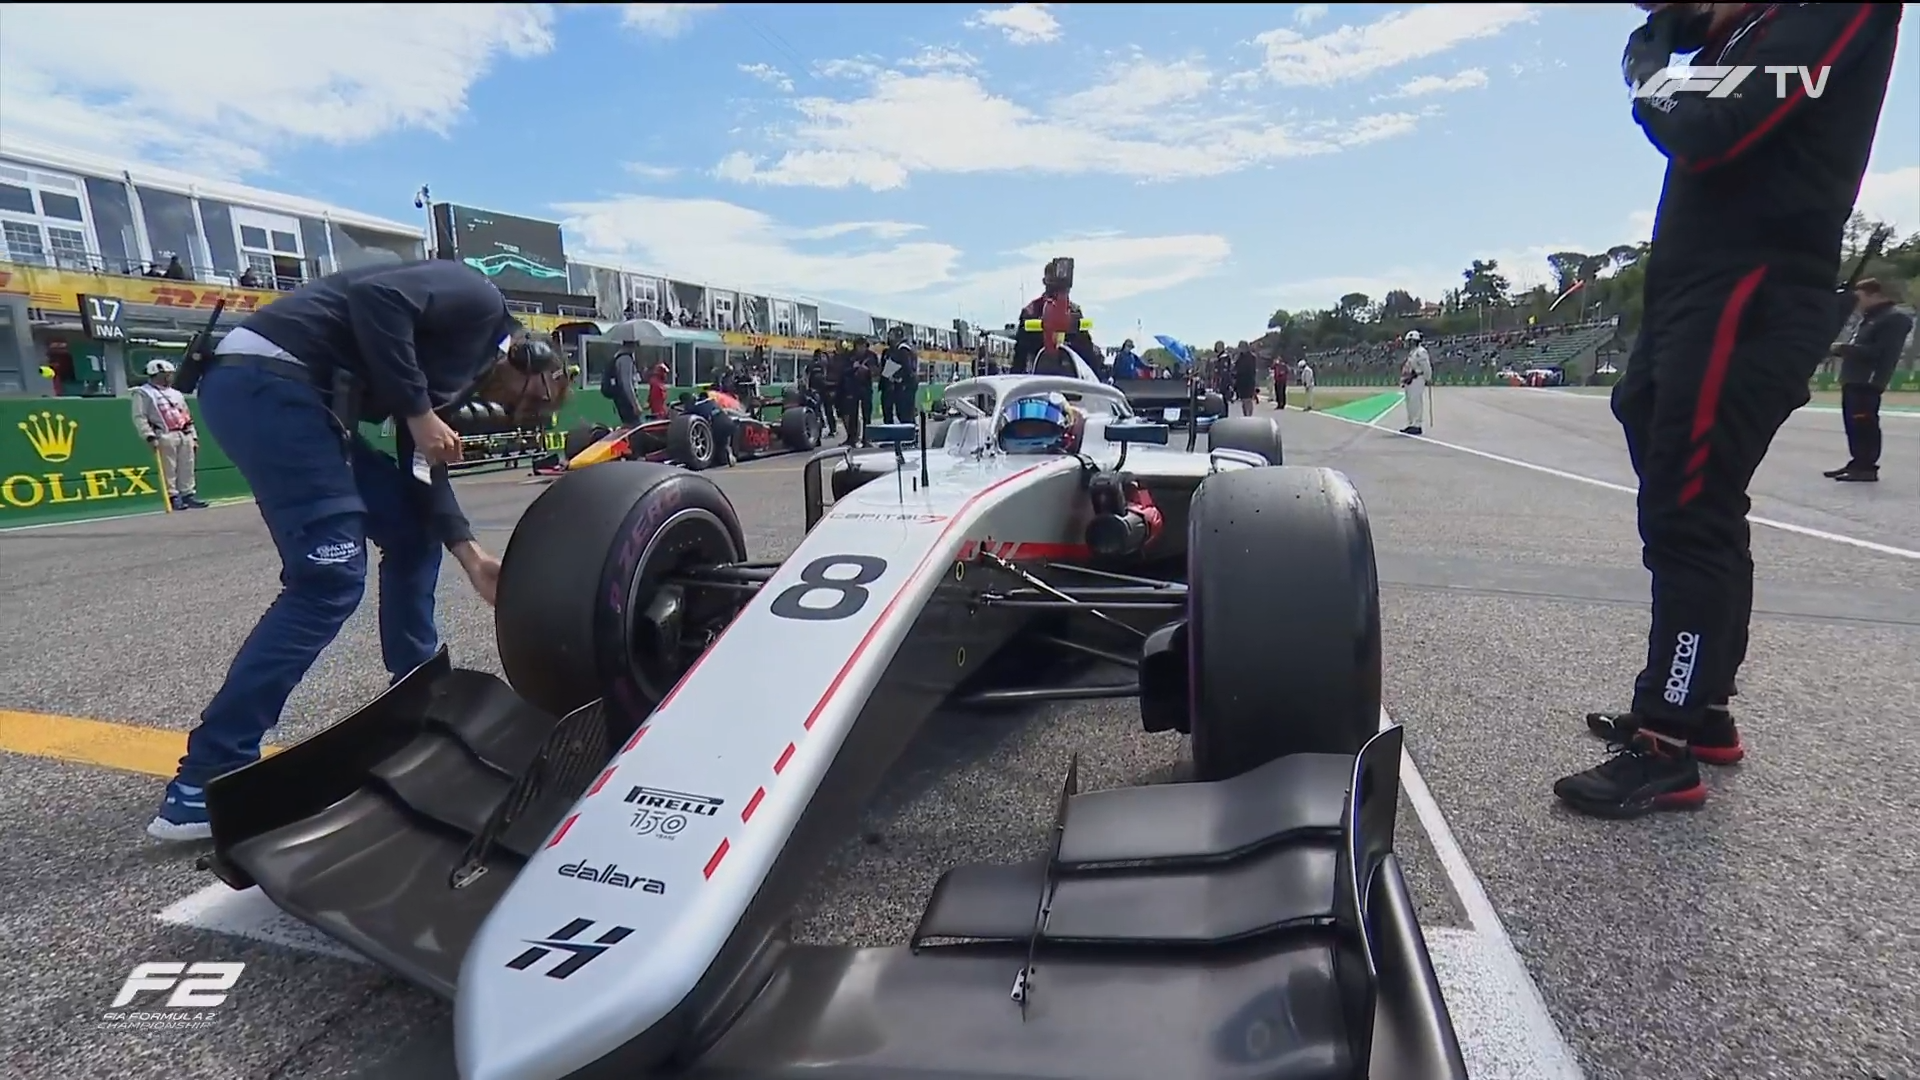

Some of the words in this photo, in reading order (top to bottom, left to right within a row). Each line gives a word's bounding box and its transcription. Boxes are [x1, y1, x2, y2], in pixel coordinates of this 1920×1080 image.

[89, 297, 121, 322] 17
[96, 324, 124, 338] IWA
[0, 466, 158, 508] OLEX
[770, 554, 888, 621] 8
[623, 785, 725, 816] PIRELLI
[630, 808, 687, 835] 150
[558, 859, 665, 895] dallara
